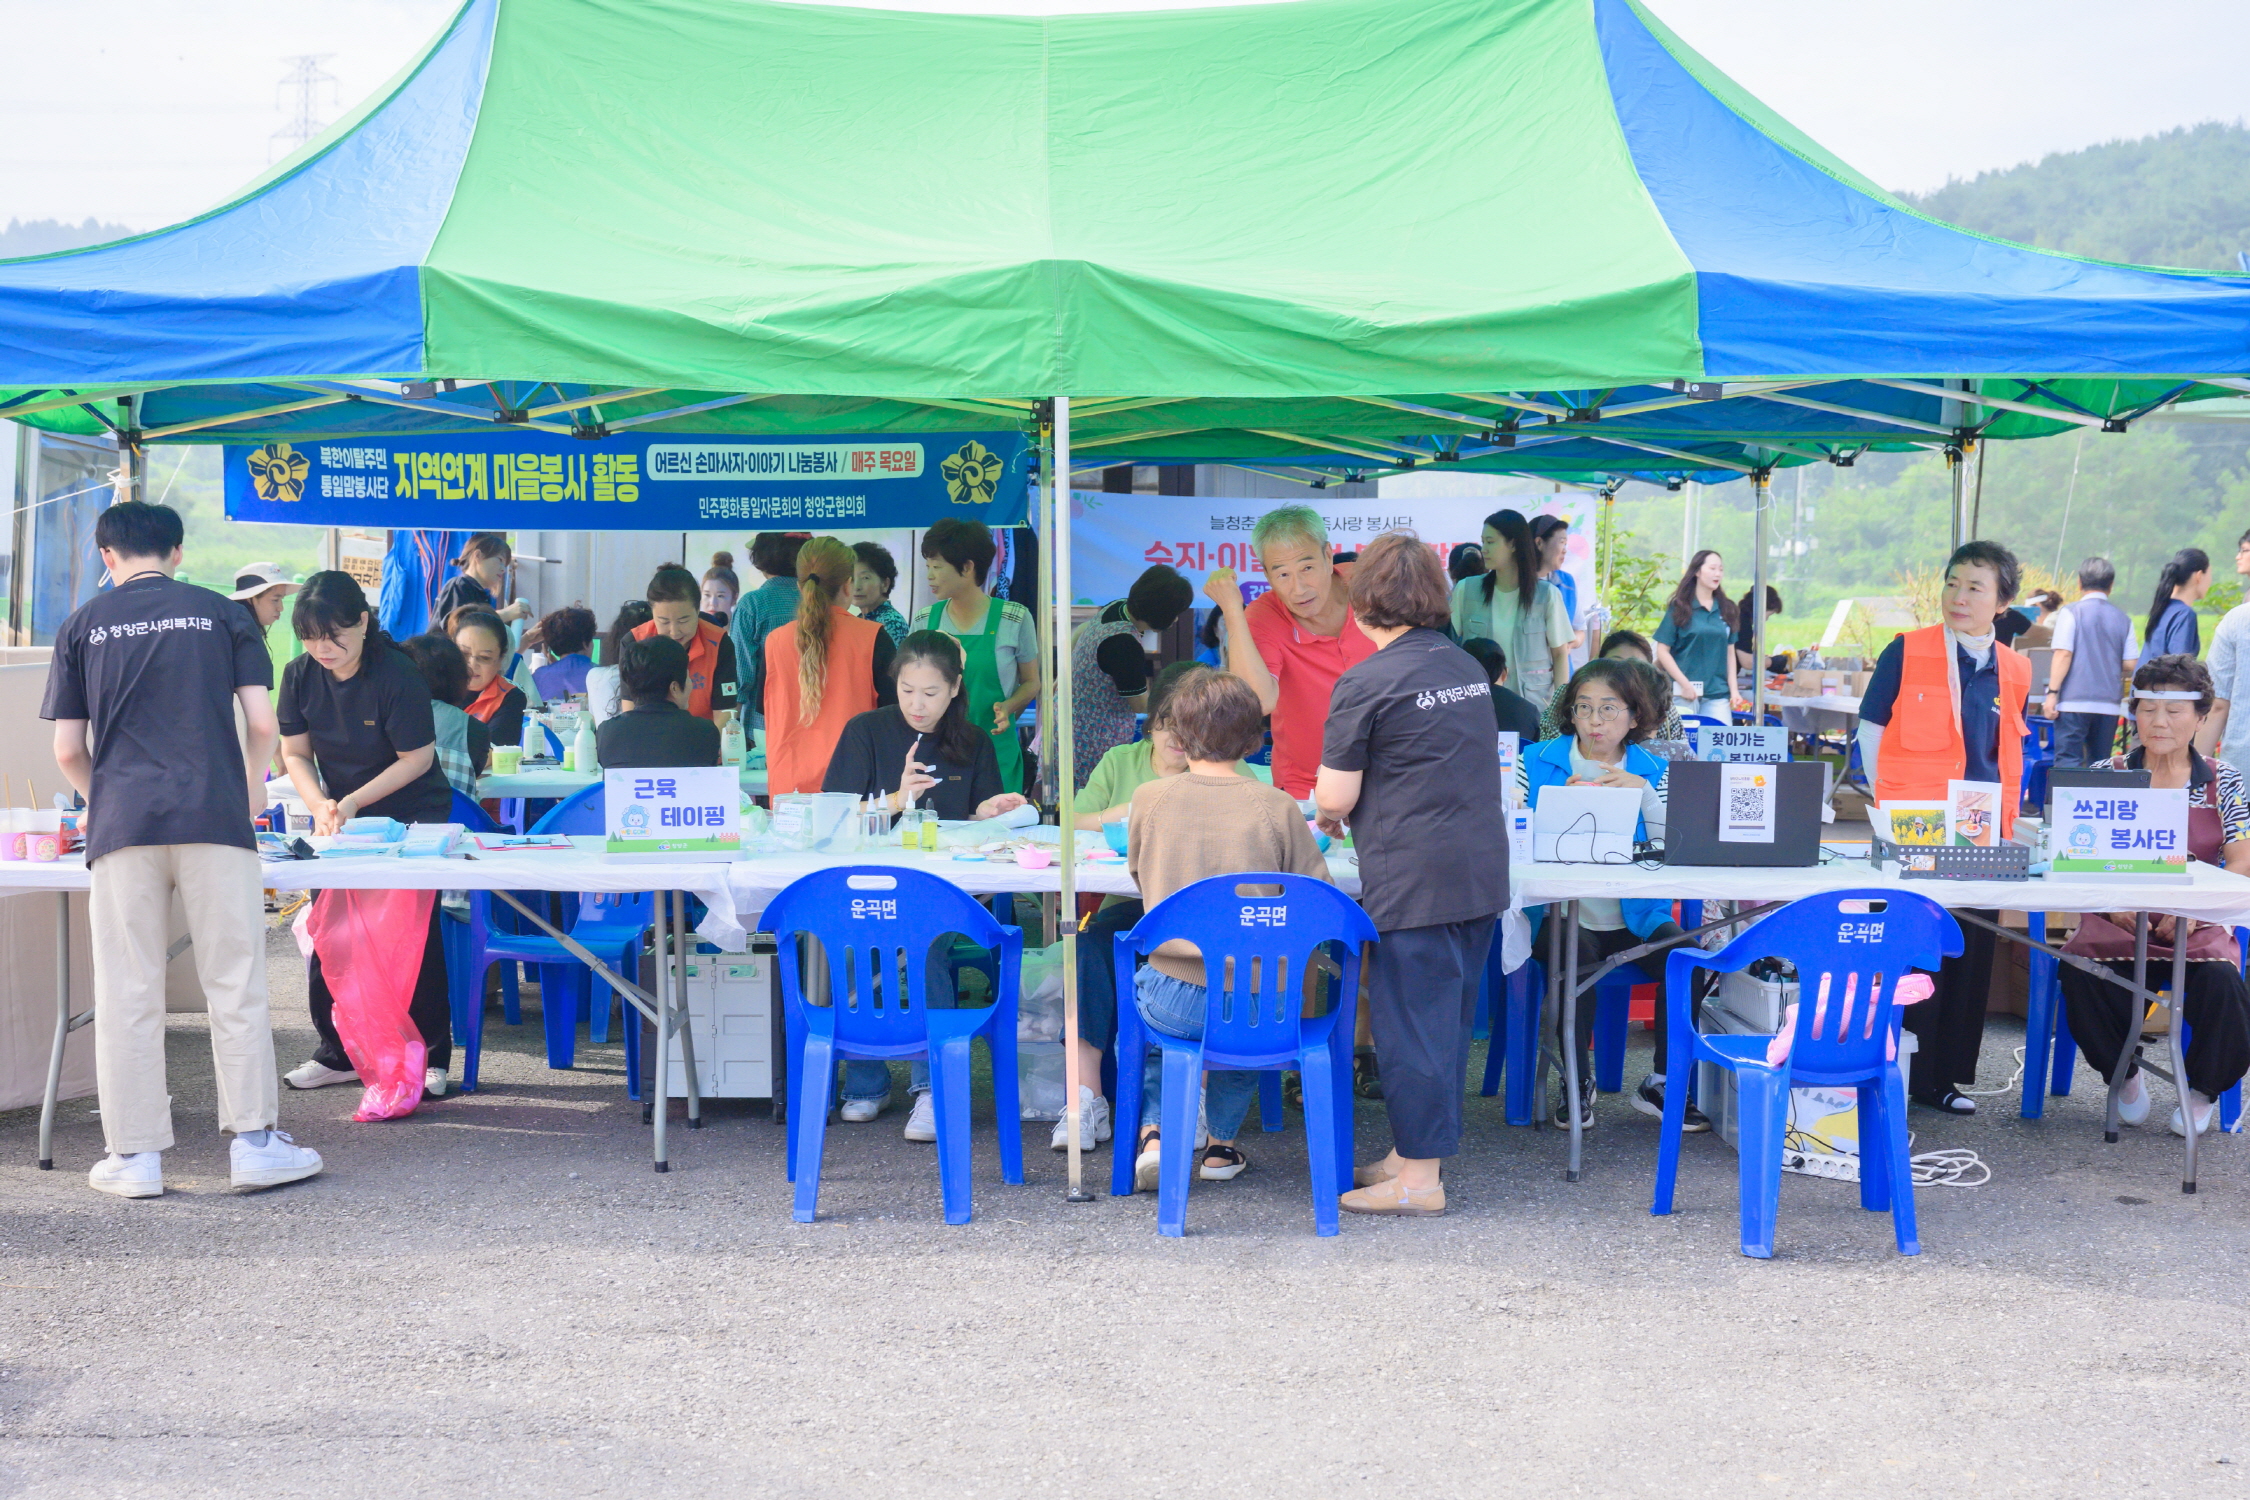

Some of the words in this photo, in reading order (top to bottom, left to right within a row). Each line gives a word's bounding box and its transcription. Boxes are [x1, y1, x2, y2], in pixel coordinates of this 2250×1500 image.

[319, 446, 388, 470] 북한이탈주민
[654, 451, 692, 474] 어르신
[695, 451, 785, 474] 손마사지·이야기
[788, 451, 838, 474] 나눔봉사
[851, 450, 876, 473] 매주
[879, 450, 916, 473] 목요일
[320, 474, 389, 499] 통일맘봉사단
[393, 452, 489, 501] 지역연계
[493, 453, 588, 502] 마을봉사
[592, 453, 640, 503] 활동
[698, 496, 802, 519] 민주평화통일자문회의
[804, 494, 866, 518] 청양군협의회
[109, 616, 213, 639] 청양군사회복지관
[1712, 732, 1765, 747] 찾아가는
[634, 778, 677, 799] 근육
[660, 805, 725, 827] 테이핑
[2072, 799, 2139, 821] 쓰리랑
[620, 828, 650, 836] WELCOME
[2110, 828, 2177, 850] 봉사단
[850, 898, 897, 920] 운곡면
[1239, 905, 1287, 927] 운곡면
[1837, 921, 1885, 944] 운곡면
